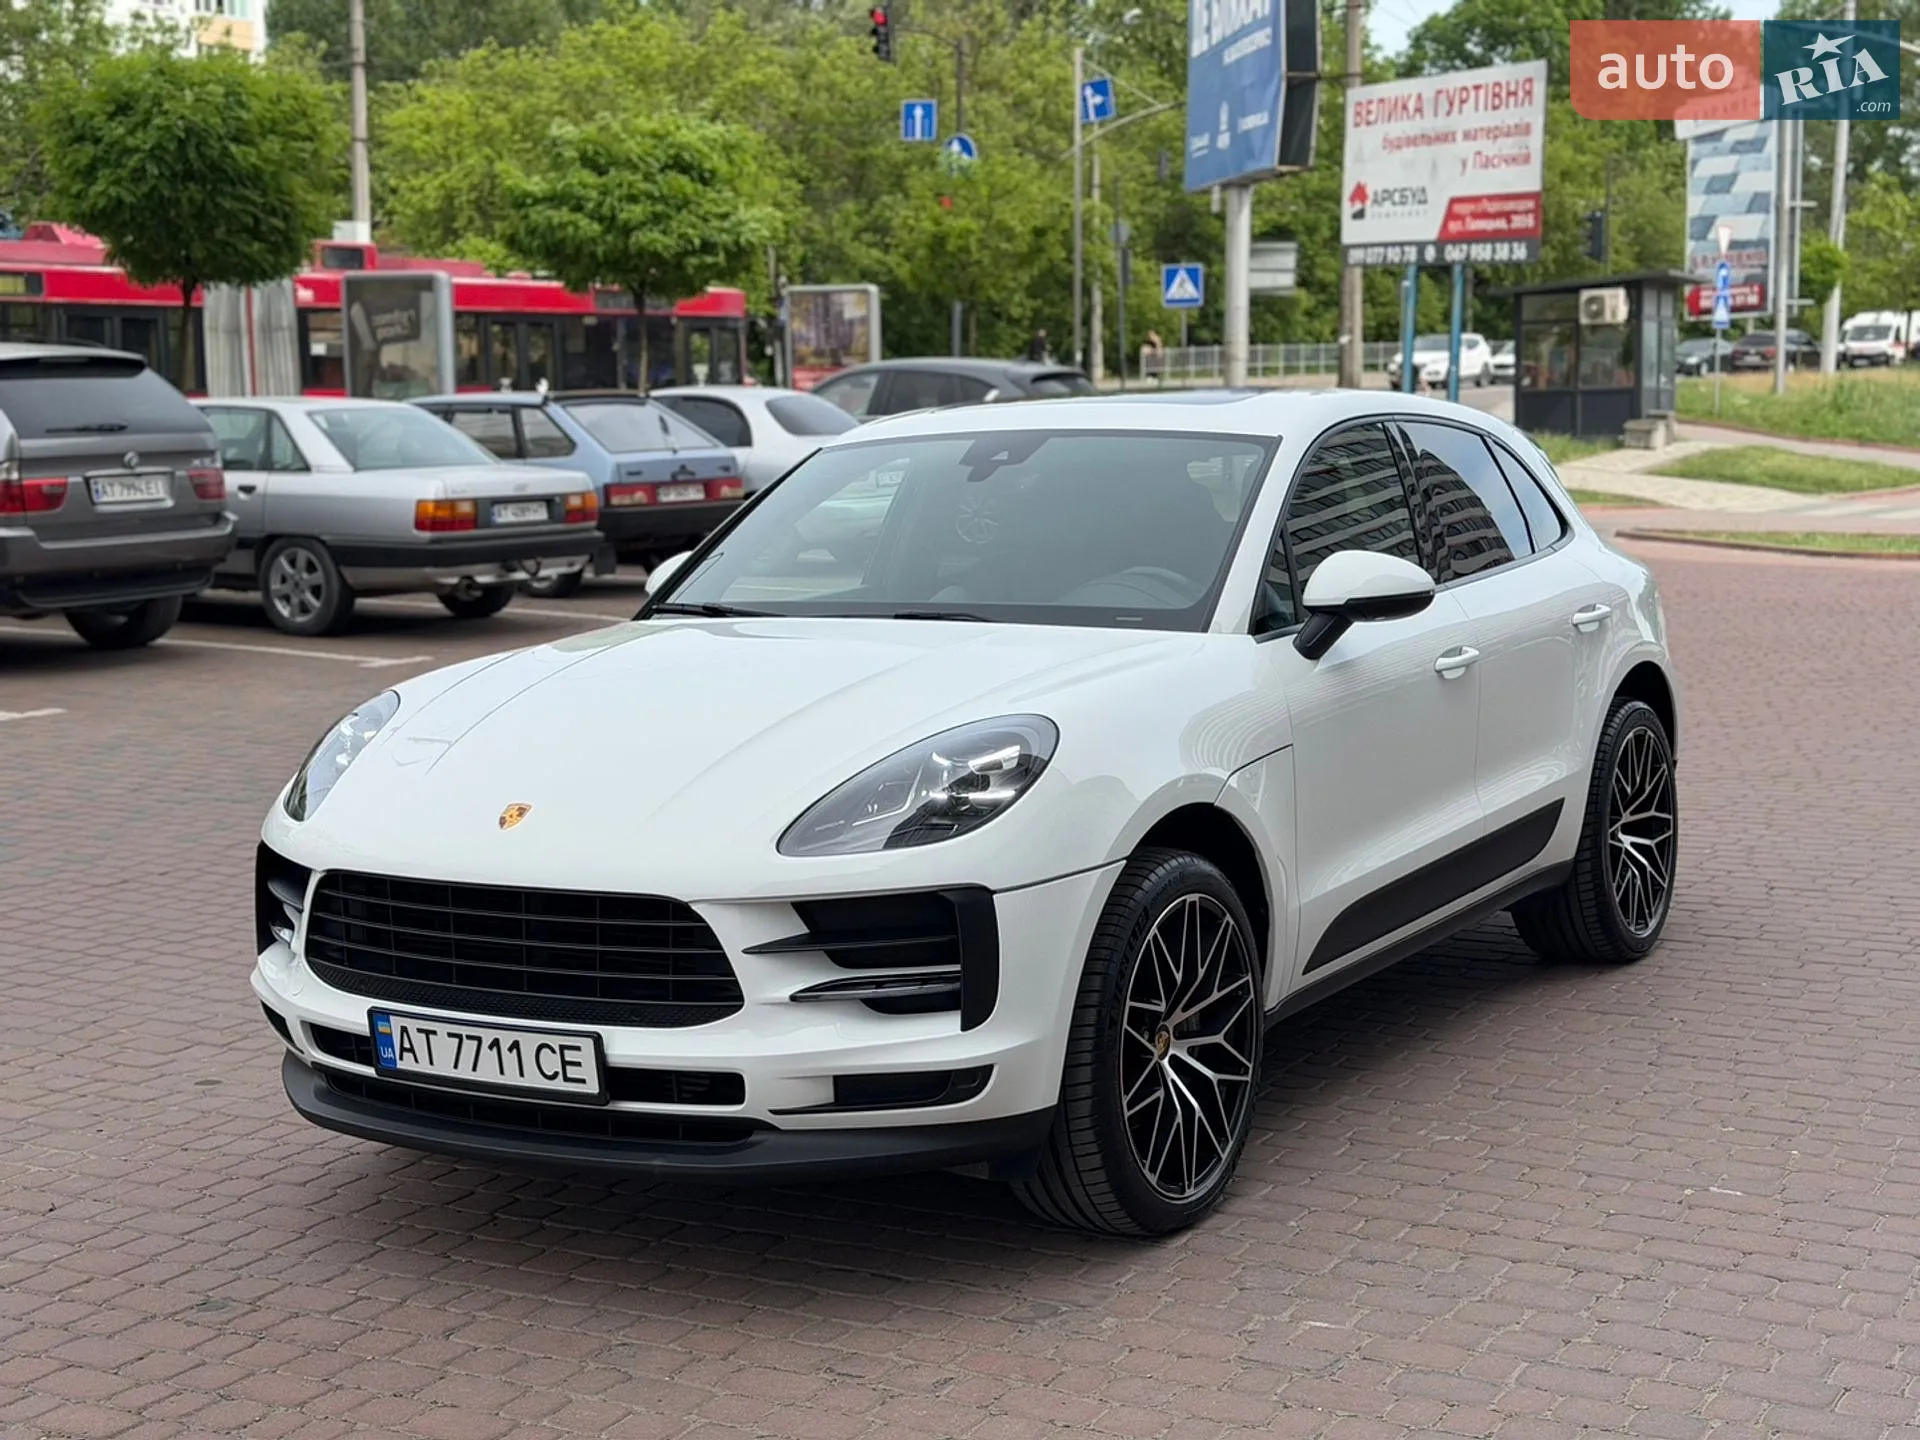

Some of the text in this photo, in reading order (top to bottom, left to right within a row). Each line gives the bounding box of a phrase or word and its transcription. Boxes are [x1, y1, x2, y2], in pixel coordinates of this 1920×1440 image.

[1353, 77, 1535, 128] ВЕЛИКА ГУРТІВНЯ
[1371, 186, 1428, 207] АРСБУД
[380, 1046, 395, 1060] UA
[399, 1025, 587, 1084] AT 7711 CE
